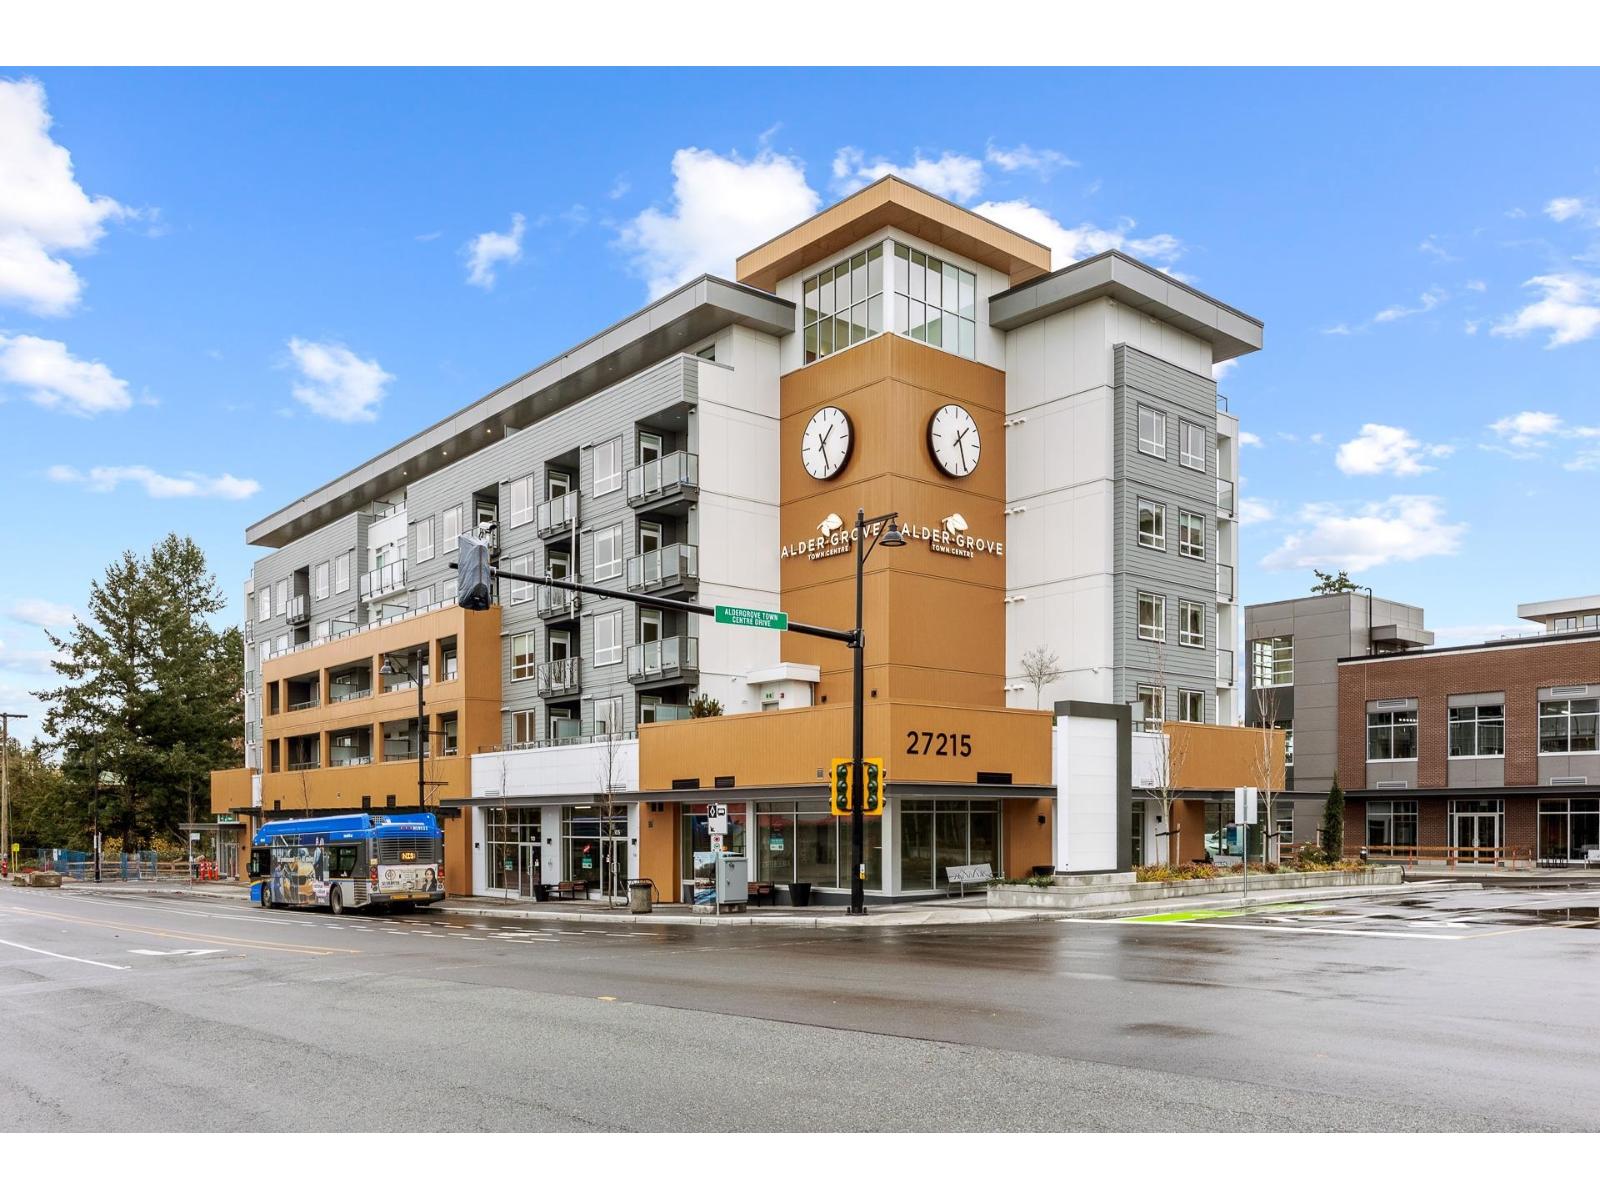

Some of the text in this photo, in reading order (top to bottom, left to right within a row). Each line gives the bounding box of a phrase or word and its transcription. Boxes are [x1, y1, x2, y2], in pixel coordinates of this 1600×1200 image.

[807, 545, 849, 561] TOWN CENTRE
[931, 543, 974, 558] TOWN CENTRE
[724, 608, 778, 621] ALDERGROVE TOWN
[732, 616, 772, 627] CENTRE DRIVE
[906, 730, 972, 758] 27215
